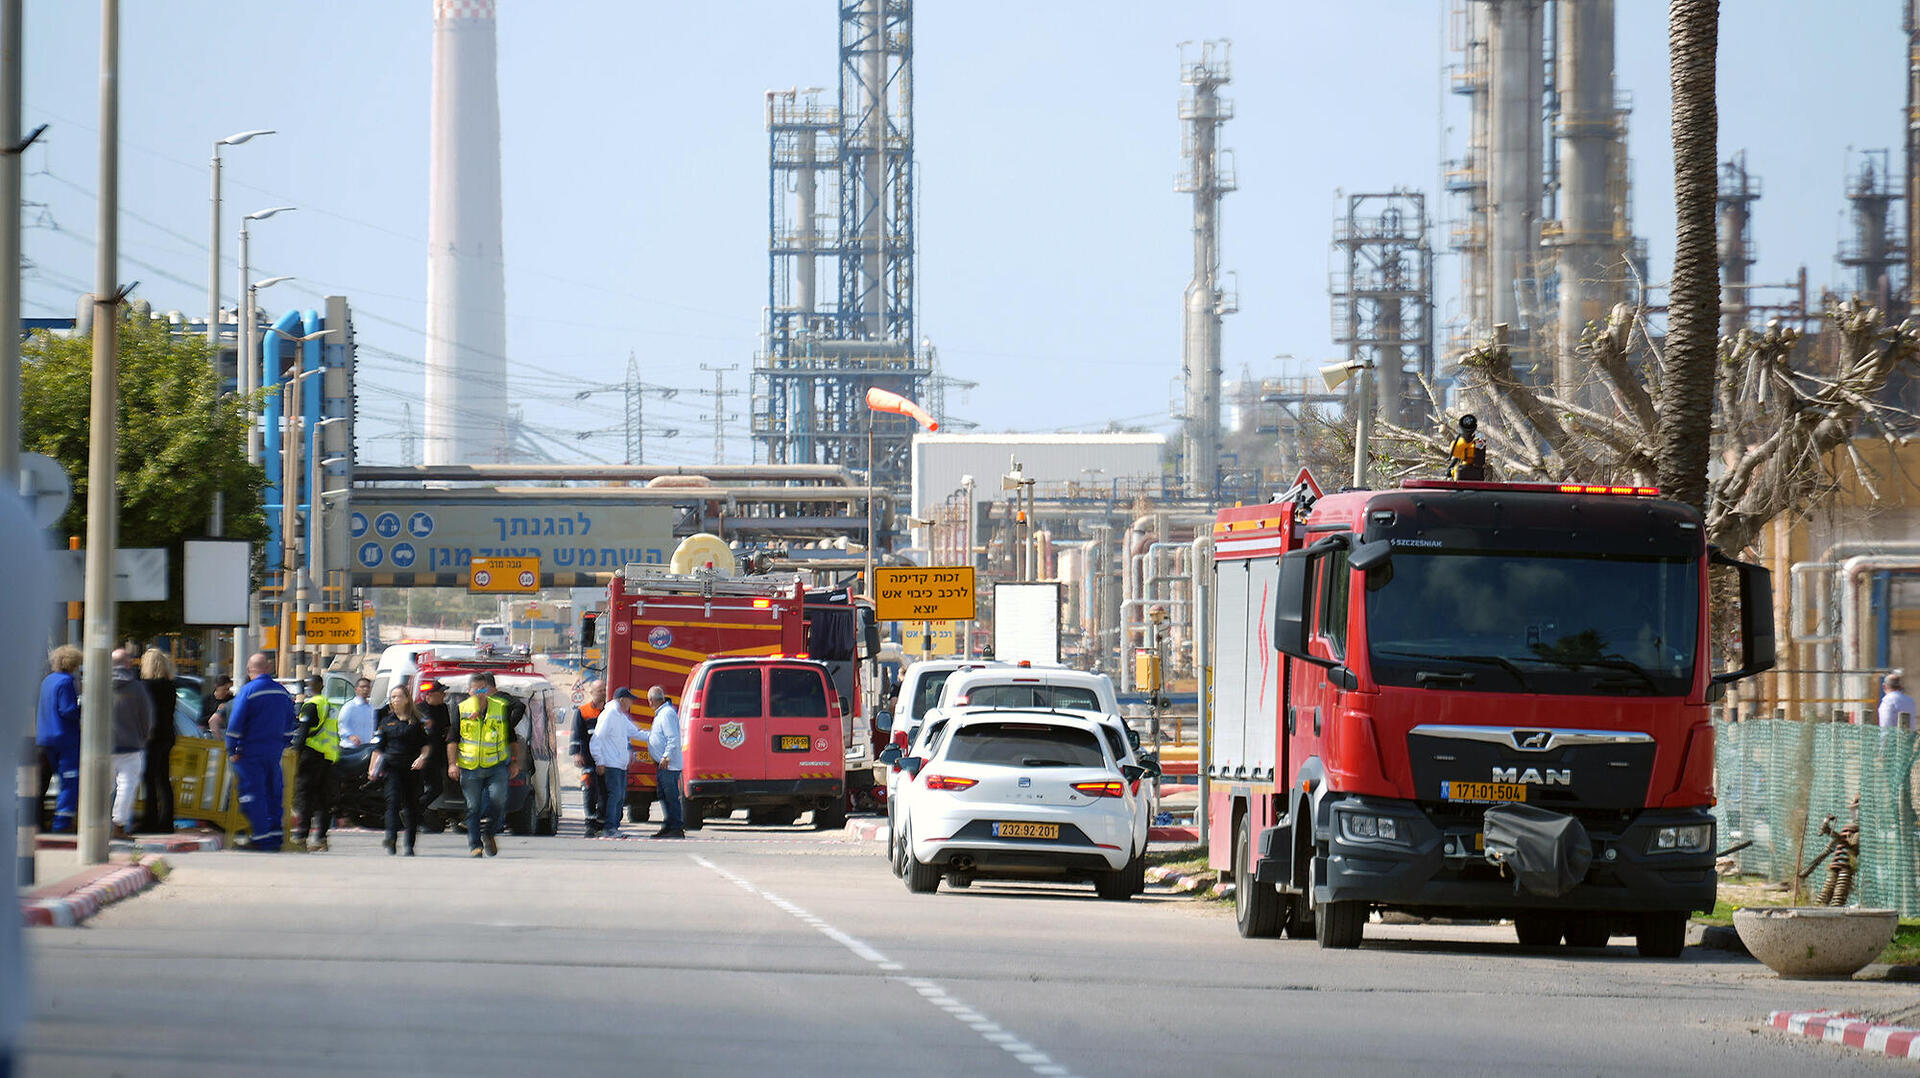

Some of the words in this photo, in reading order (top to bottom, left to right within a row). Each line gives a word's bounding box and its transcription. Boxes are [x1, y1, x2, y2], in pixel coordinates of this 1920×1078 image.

[492, 511, 592, 541] להגנתך
[429, 547, 472, 572] מגן
[553, 547, 663, 567] השתמש
[889, 574, 928, 585] קדימה
[933, 573, 960, 583] זכות
[881, 590, 902, 599] אש
[906, 589, 933, 598] כיבוי
[937, 586, 969, 598] לרכב
[913, 604, 938, 613] יוצא
[311, 616, 341, 625] כניסה
[328, 628, 357, 637] לאזור
[1491, 766, 1572, 786] MAN
